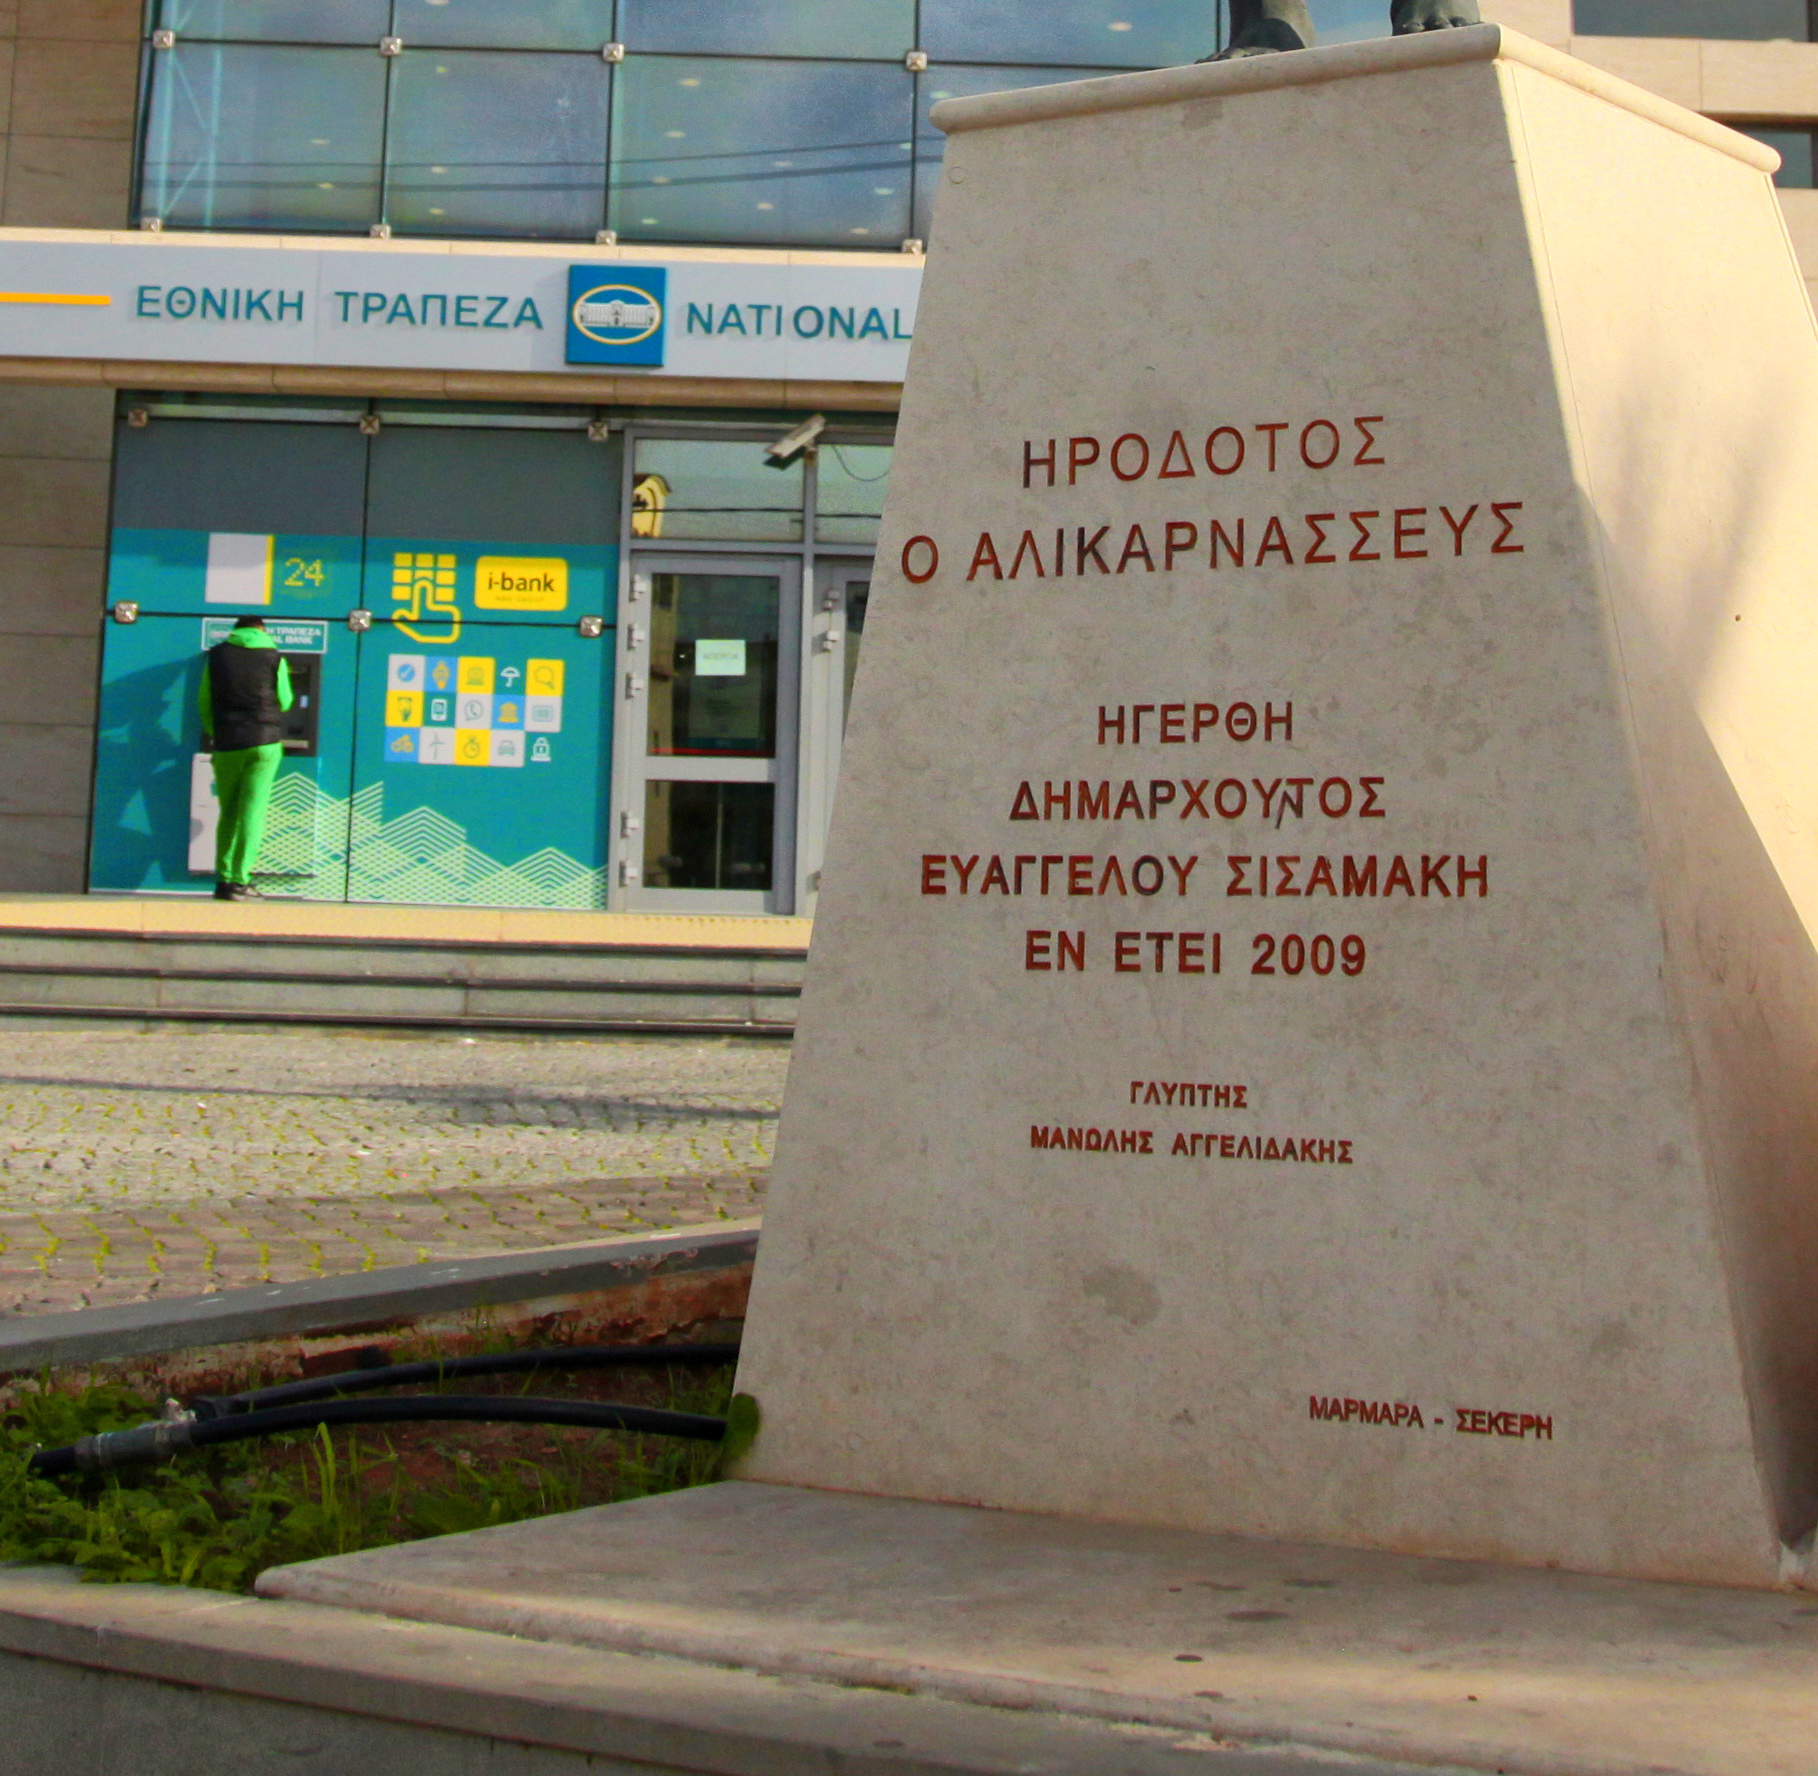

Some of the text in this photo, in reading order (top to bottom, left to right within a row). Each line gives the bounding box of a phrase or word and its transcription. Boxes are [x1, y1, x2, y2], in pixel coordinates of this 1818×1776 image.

[135, 284, 545, 331] ΕΘΝΙΚΗ ΤΡΑΠΕΖΑ
[685, 301, 913, 342] NATIONAL
[1022, 414, 1386, 490] ΗΡΟΔΟΤΟΣ
[900, 500, 1525, 586] Ο ΑΛΙΚΑΡΝΑΣΣΕΥΣ
[284, 557, 324, 587] 24
[487, 571, 555, 592] i-bank
[1096, 699, 1294, 746] ΗΓΕΡΘΗ
[920, 853, 1490, 899] ΕΥΑΓΓΕΛΟΥ ΣΙΣΑΜΑΚΗ
[1024, 928, 1368, 978] ΕΝ ΕΤΕΙ 2009
[1129, 1079, 1249, 1110] ΓΛΥΠΤΗΣ
[1028, 1124, 1355, 1166] ΜΑΝΩΛΗΣ ΑΓΓΕΛΙΔΑΚΗΣ
[1308, 1394, 1425, 1430] ΜΑΡΜΑΡΑ
[1454, 1406, 1554, 1441] ΣΕΚΕΡΗ
